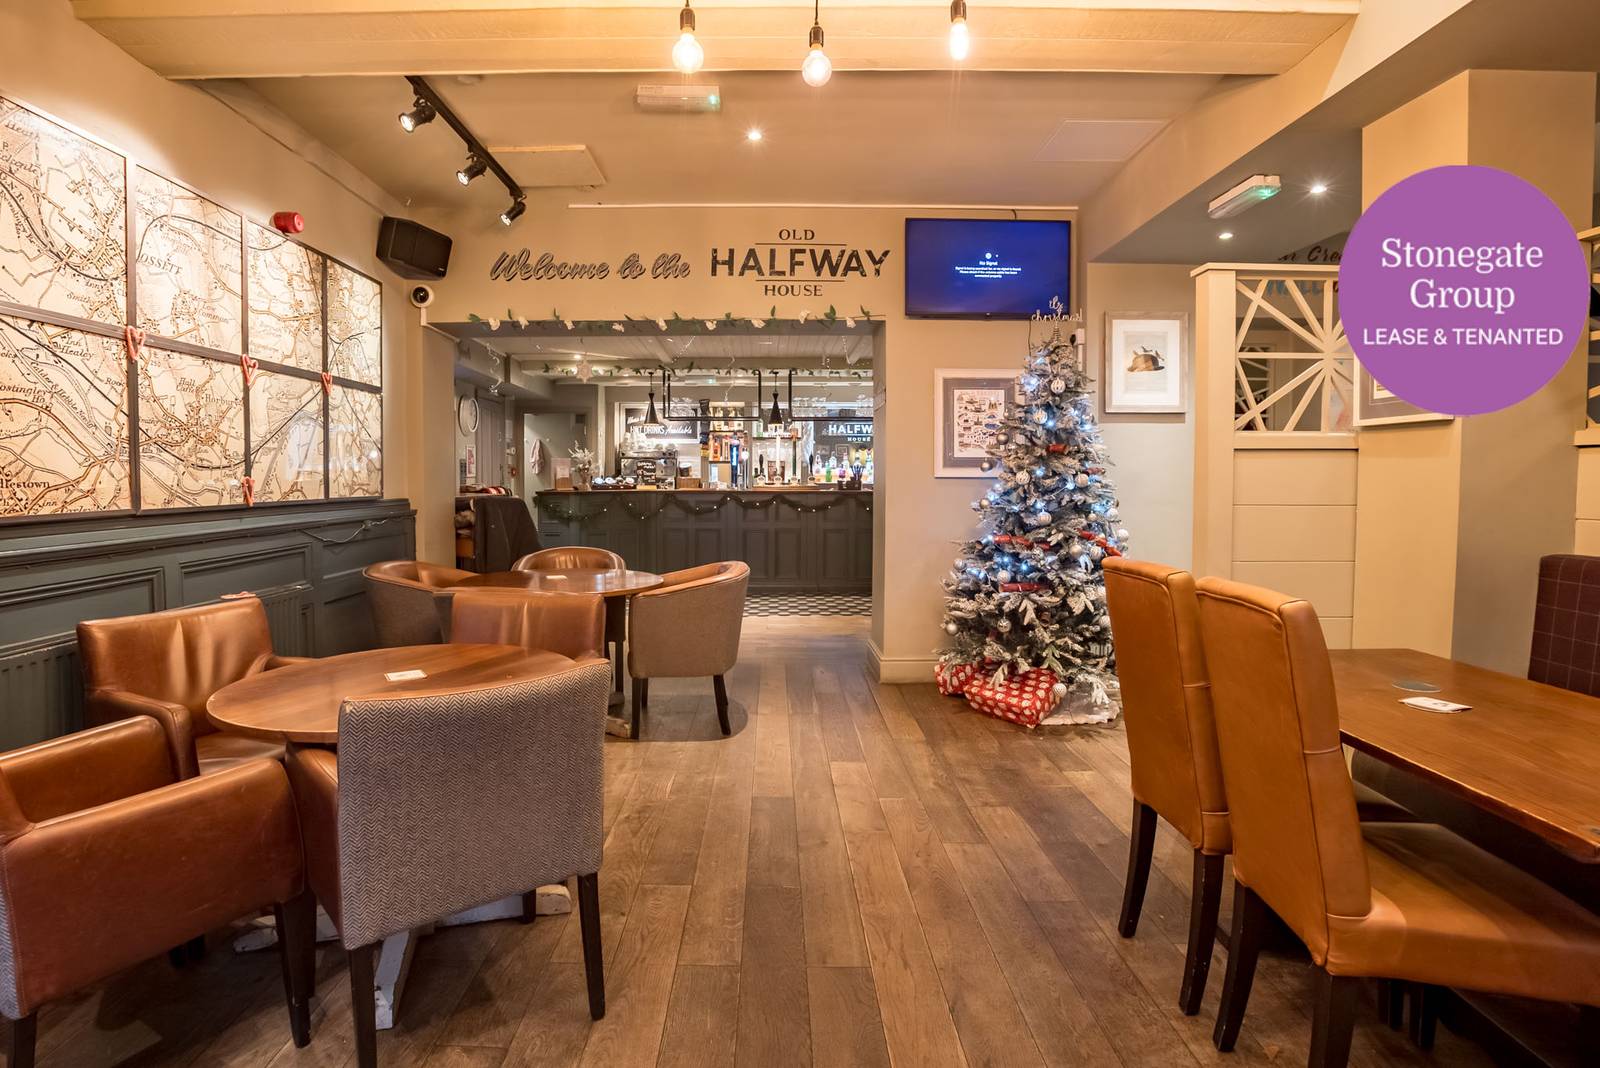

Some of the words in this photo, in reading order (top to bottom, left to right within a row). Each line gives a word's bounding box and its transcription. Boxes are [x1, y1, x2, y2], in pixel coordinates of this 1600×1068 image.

[778, 229, 816, 241] OLD
[1307, 245, 1342, 262] Cre
[489, 247, 611, 282] Welcome
[616, 252, 646, 280] to
[651, 251, 691, 280] the
[711, 248, 891, 277] HALFWAY
[764, 284, 824, 297] HOUSE
[828, 424, 873, 434] HALFW
